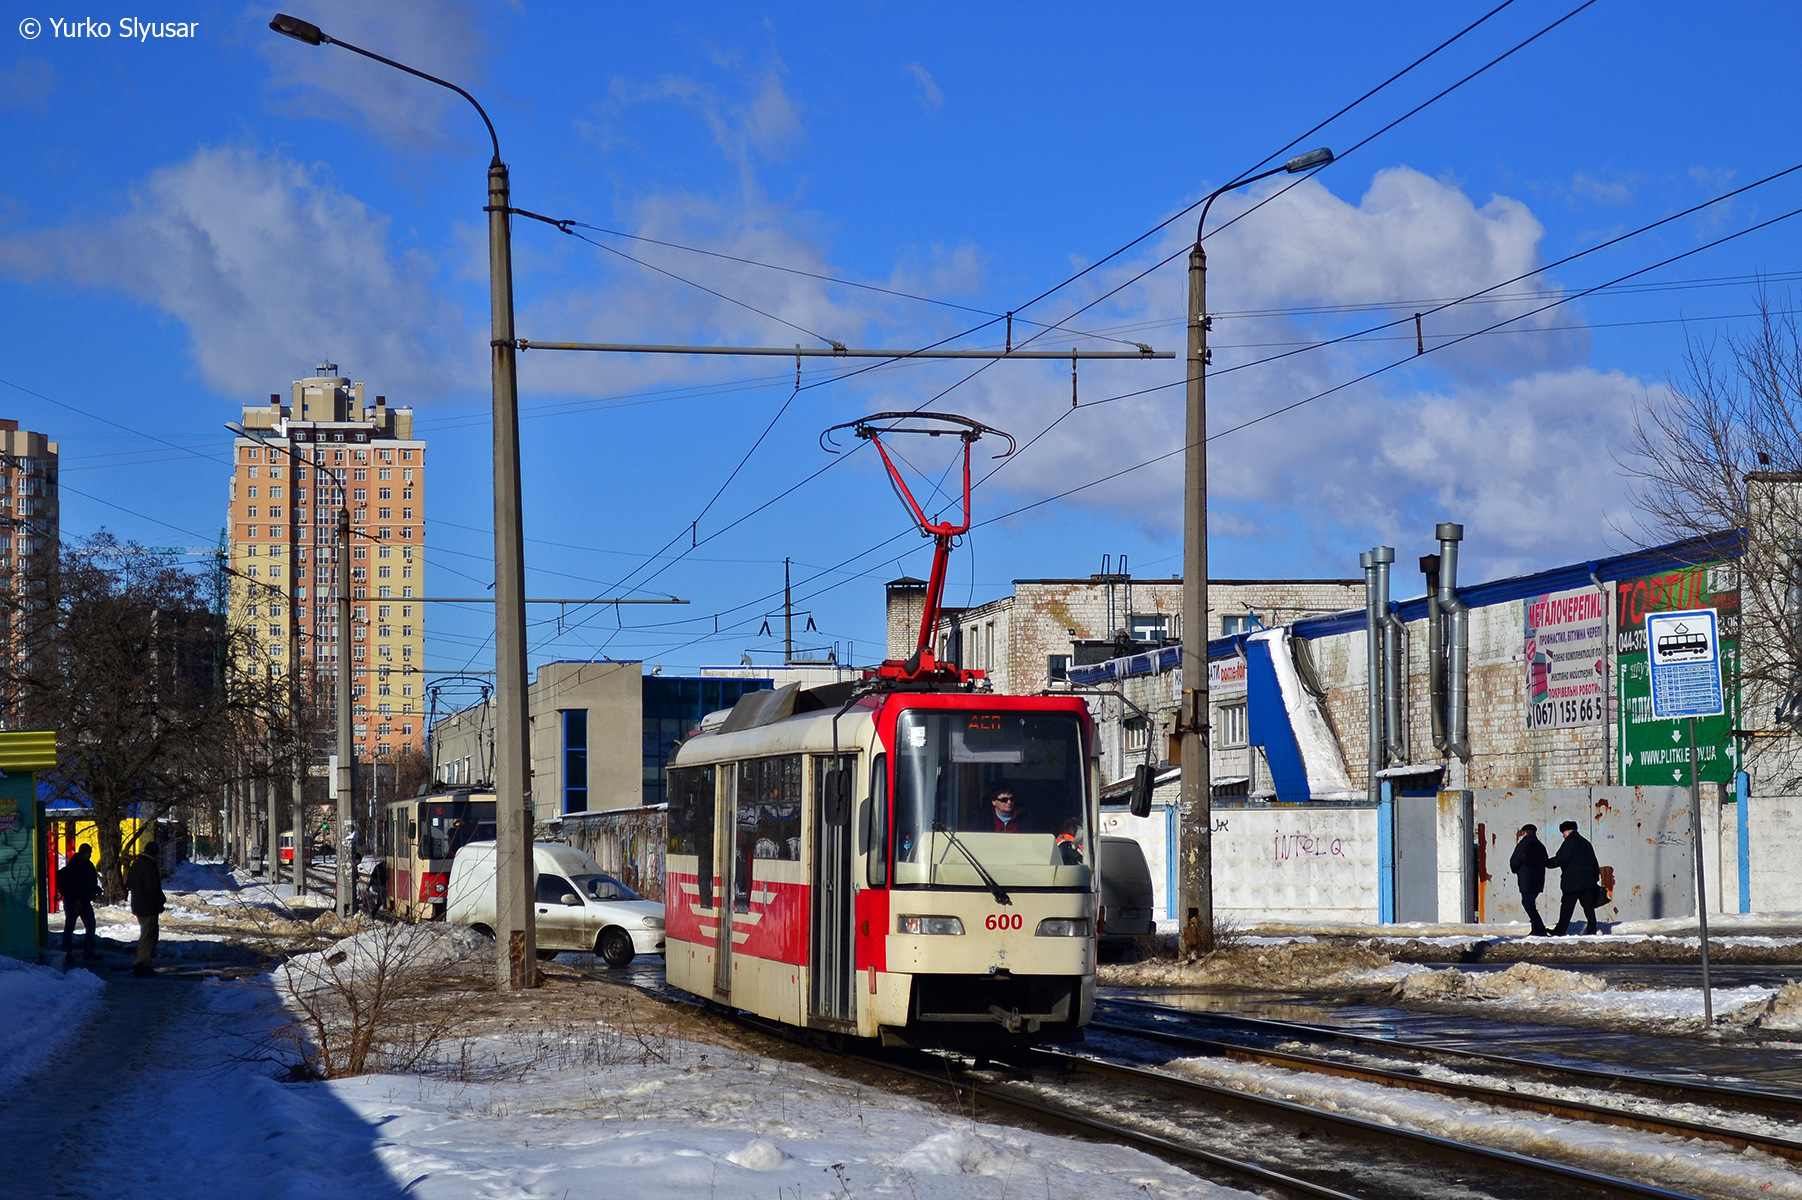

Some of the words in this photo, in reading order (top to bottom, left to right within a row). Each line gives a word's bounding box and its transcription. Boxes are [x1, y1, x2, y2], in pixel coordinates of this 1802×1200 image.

[1618, 570, 1706, 627] TOPTUL
[1533, 701, 1557, 729] (067)
[1560, 700, 1577, 723] 155
[1580, 698, 1593, 722] 66
[1596, 697, 1602, 720] 5
[985, 913, 1023, 931] 600
